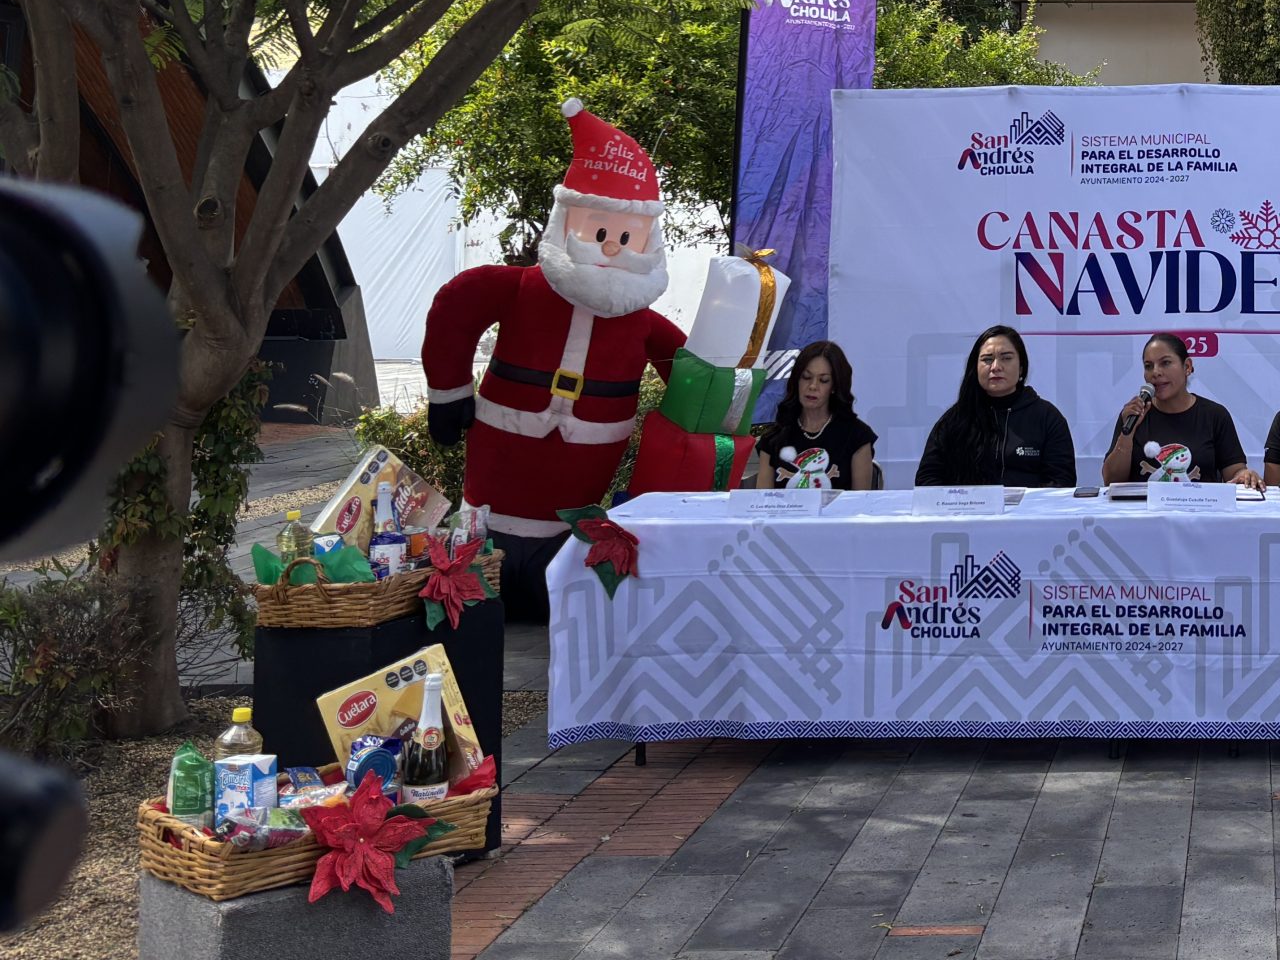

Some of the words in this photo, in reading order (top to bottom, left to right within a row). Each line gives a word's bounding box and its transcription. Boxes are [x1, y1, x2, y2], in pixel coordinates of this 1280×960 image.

[790, 4, 851, 23] CHOLULA
[971, 132, 1009, 150] San
[1081, 135, 1138, 147] SISTEMA
[1141, 133, 1212, 146] MUNICIPAL
[598, 141, 635, 161] feliz
[957, 146, 1034, 170] Andrés
[1081, 149, 1115, 161] PARA
[1119, 149, 1135, 161] EL
[1137, 148, 1221, 160] DESARROLLO
[583, 158, 648, 182] navidad
[980, 165, 1034, 176] CHOLULA
[1081, 163, 1144, 174] INTEGRAL
[1147, 162, 1165, 173] DE
[1167, 162, 1184, 173] LA
[1186, 161, 1238, 173] FAMILIA
[1080, 176, 1143, 186] AYUNTAMIENTO
[1144, 174, 1190, 185] 2024-2027
[977, 210, 1205, 251] CANASTA
[899, 580, 948, 604] San
[1043, 585, 1117, 600] SISTEMA
[1120, 585, 1212, 601] MUNICIPAL
[881, 601, 981, 630] Andrés
[1042, 605, 1087, 618] PARA
[1091, 605, 1112, 618] EL
[1115, 605, 1224, 620] DESARROLLO
[910, 626, 981, 639] CHOLULA
[1042, 623, 1124, 636] INTEGRAL
[1128, 623, 1150, 636] DE
[1155, 623, 1176, 637] LA
[1180, 624, 1246, 638] FAMILIA
[1041, 641, 1123, 651] AYUNTAMIENTO
[1125, 641, 1184, 652] 2024-2027
[337, 693, 377, 725] Cuétara
